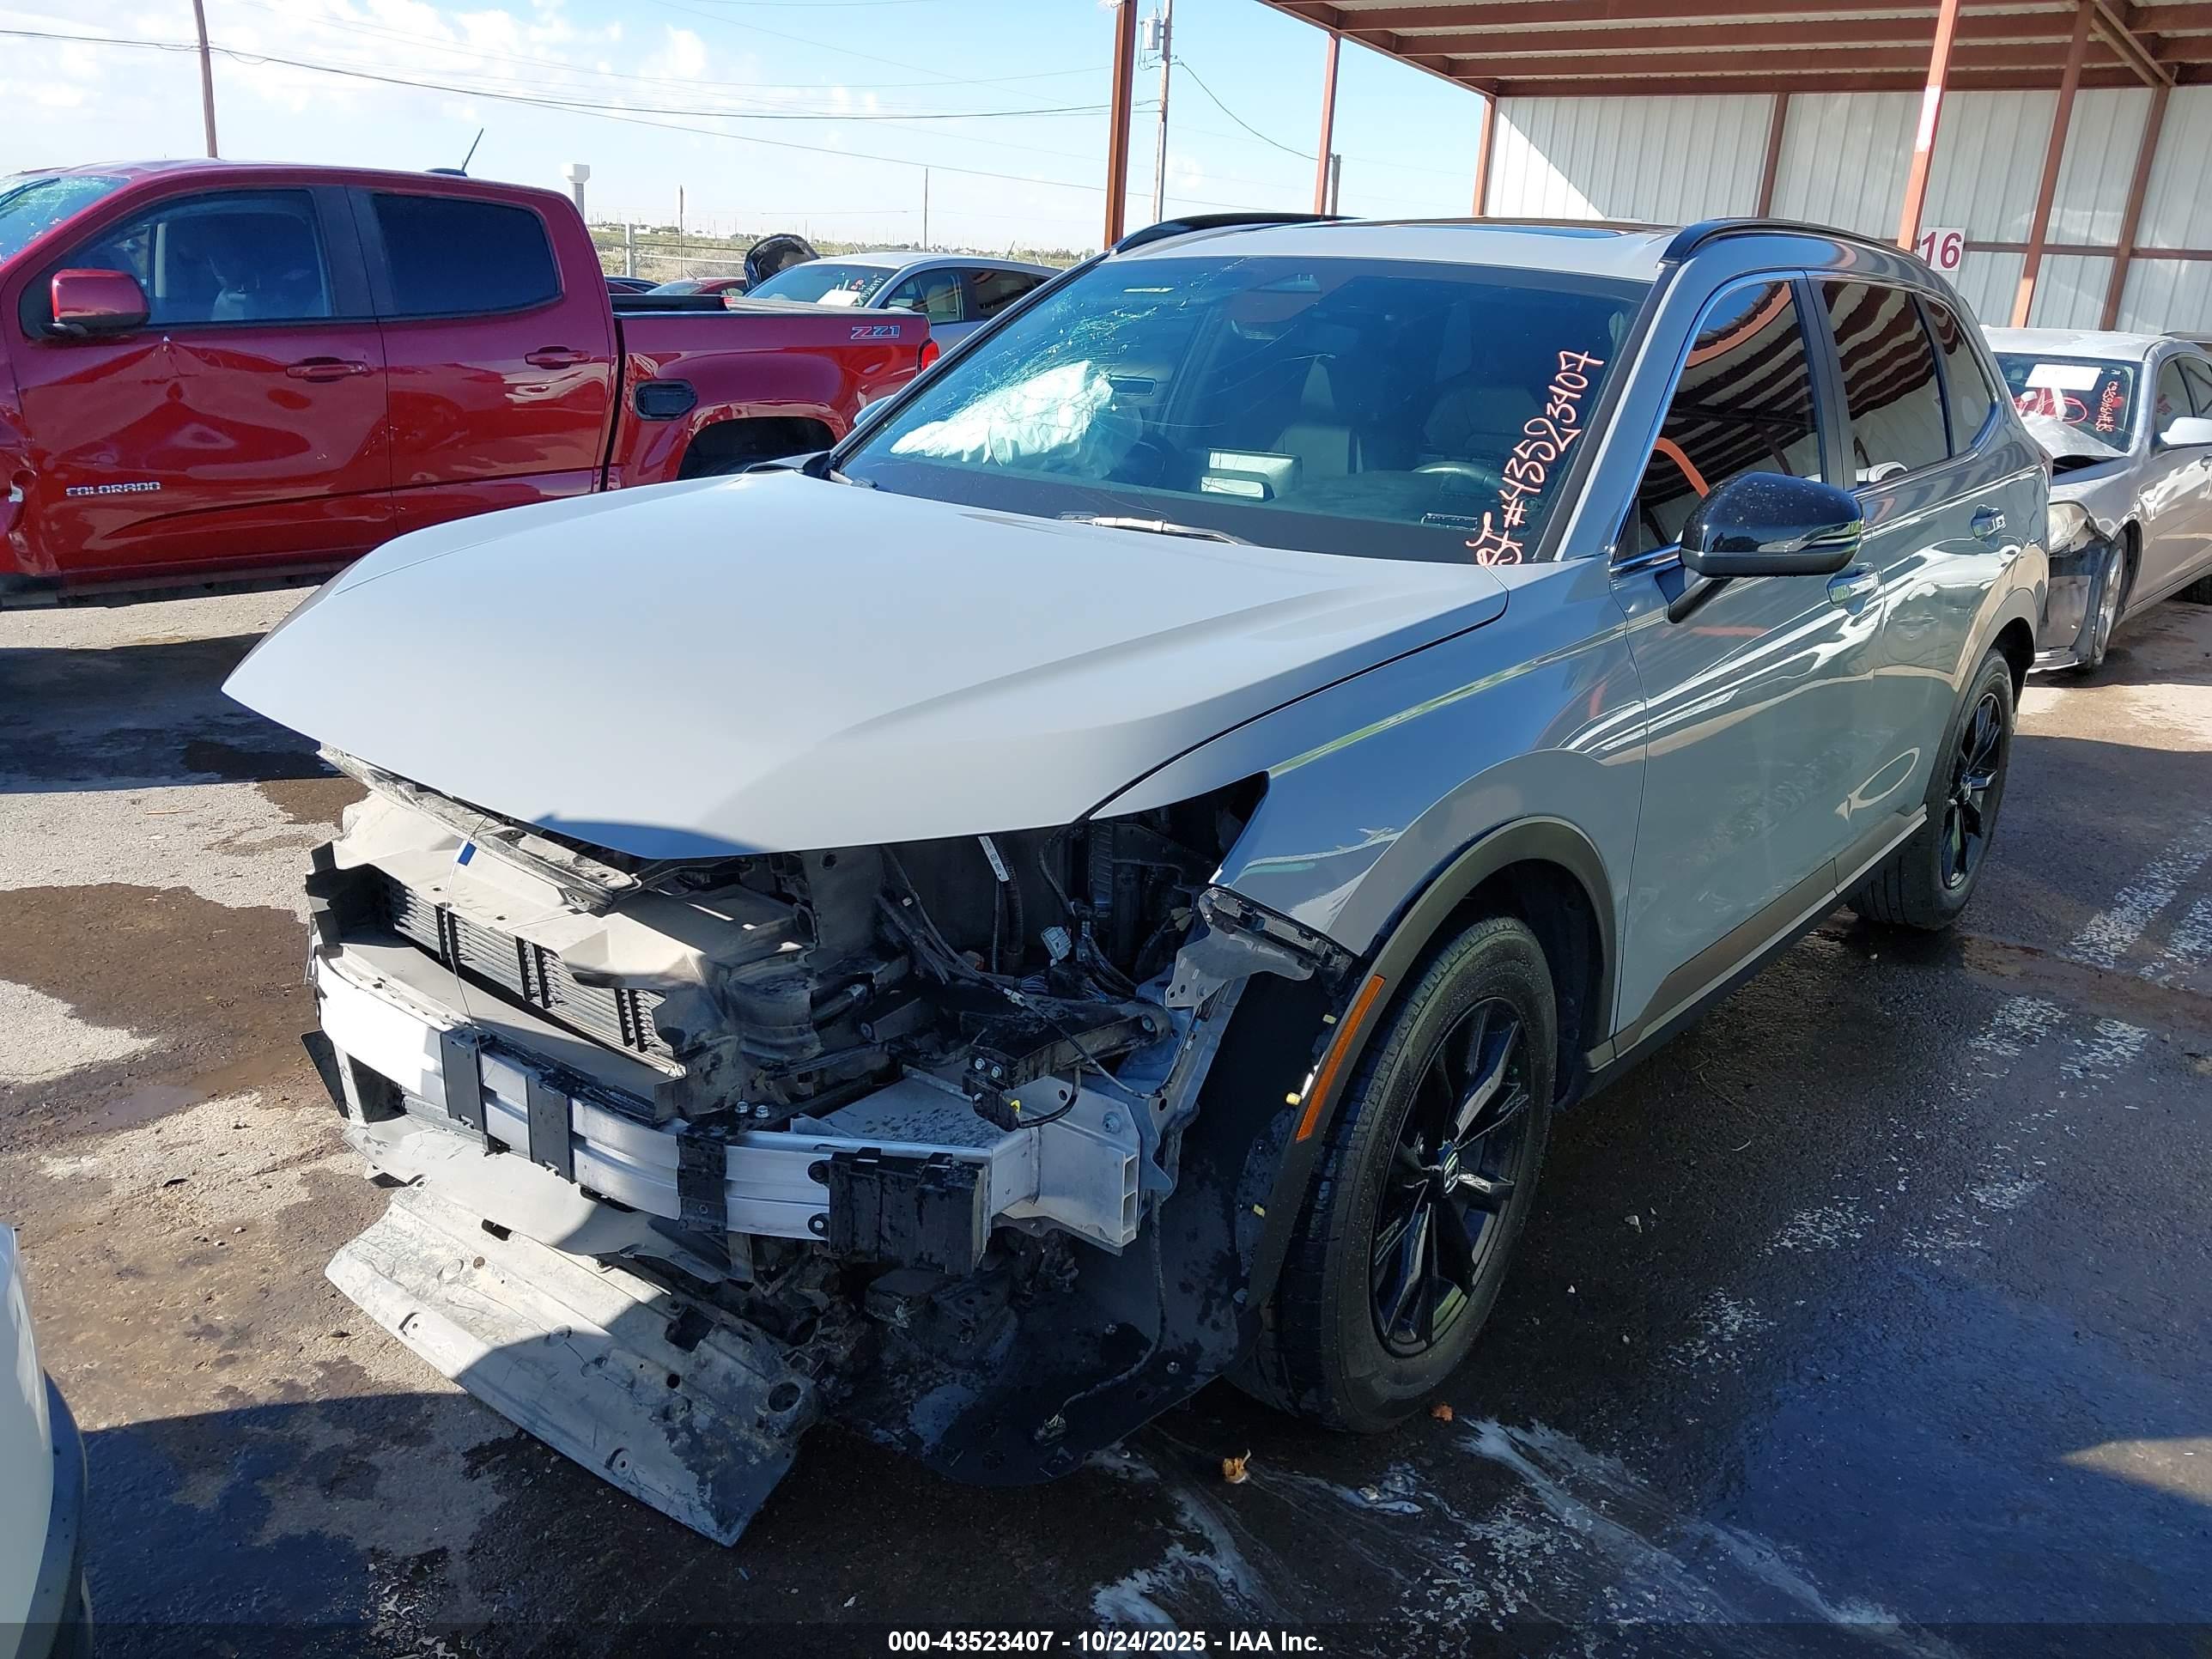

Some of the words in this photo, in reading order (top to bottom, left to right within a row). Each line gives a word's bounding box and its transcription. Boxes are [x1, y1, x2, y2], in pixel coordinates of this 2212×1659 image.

[1922, 231, 1962, 269] 16
[850, 325, 901, 340] Z71
[65, 481, 161, 496] COLORADO
